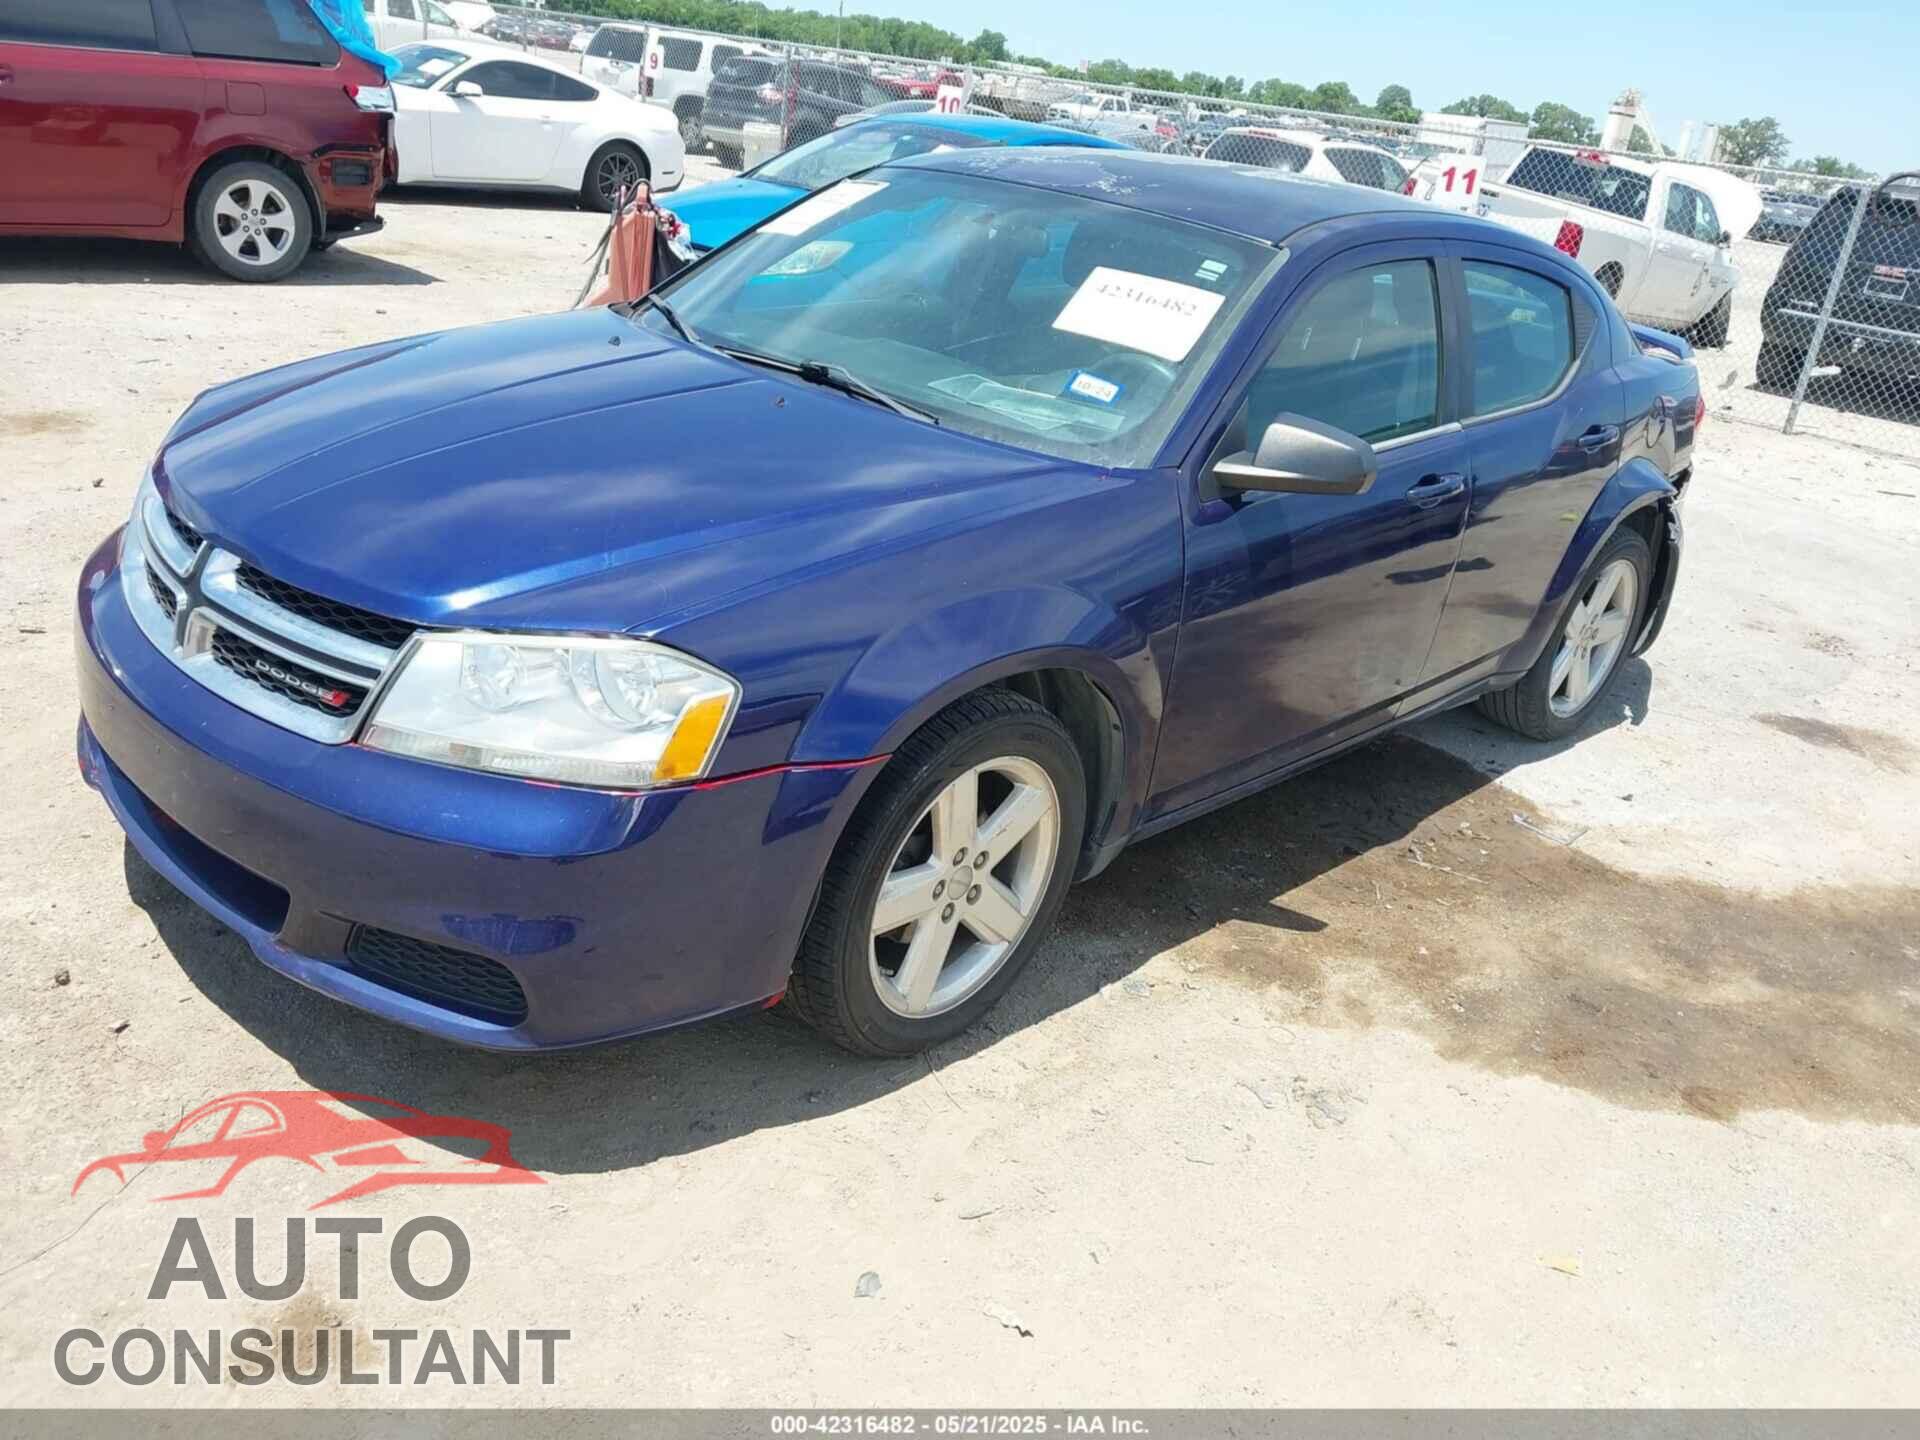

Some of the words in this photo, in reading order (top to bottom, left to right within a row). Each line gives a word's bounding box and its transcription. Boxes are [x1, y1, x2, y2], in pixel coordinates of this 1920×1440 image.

[650, 52, 658, 69] 9
[938, 96, 960, 114] 10
[1442, 166, 1477, 195] 11
[1097, 283, 1197, 316] 42316482
[255, 659, 334, 702] DODGE
